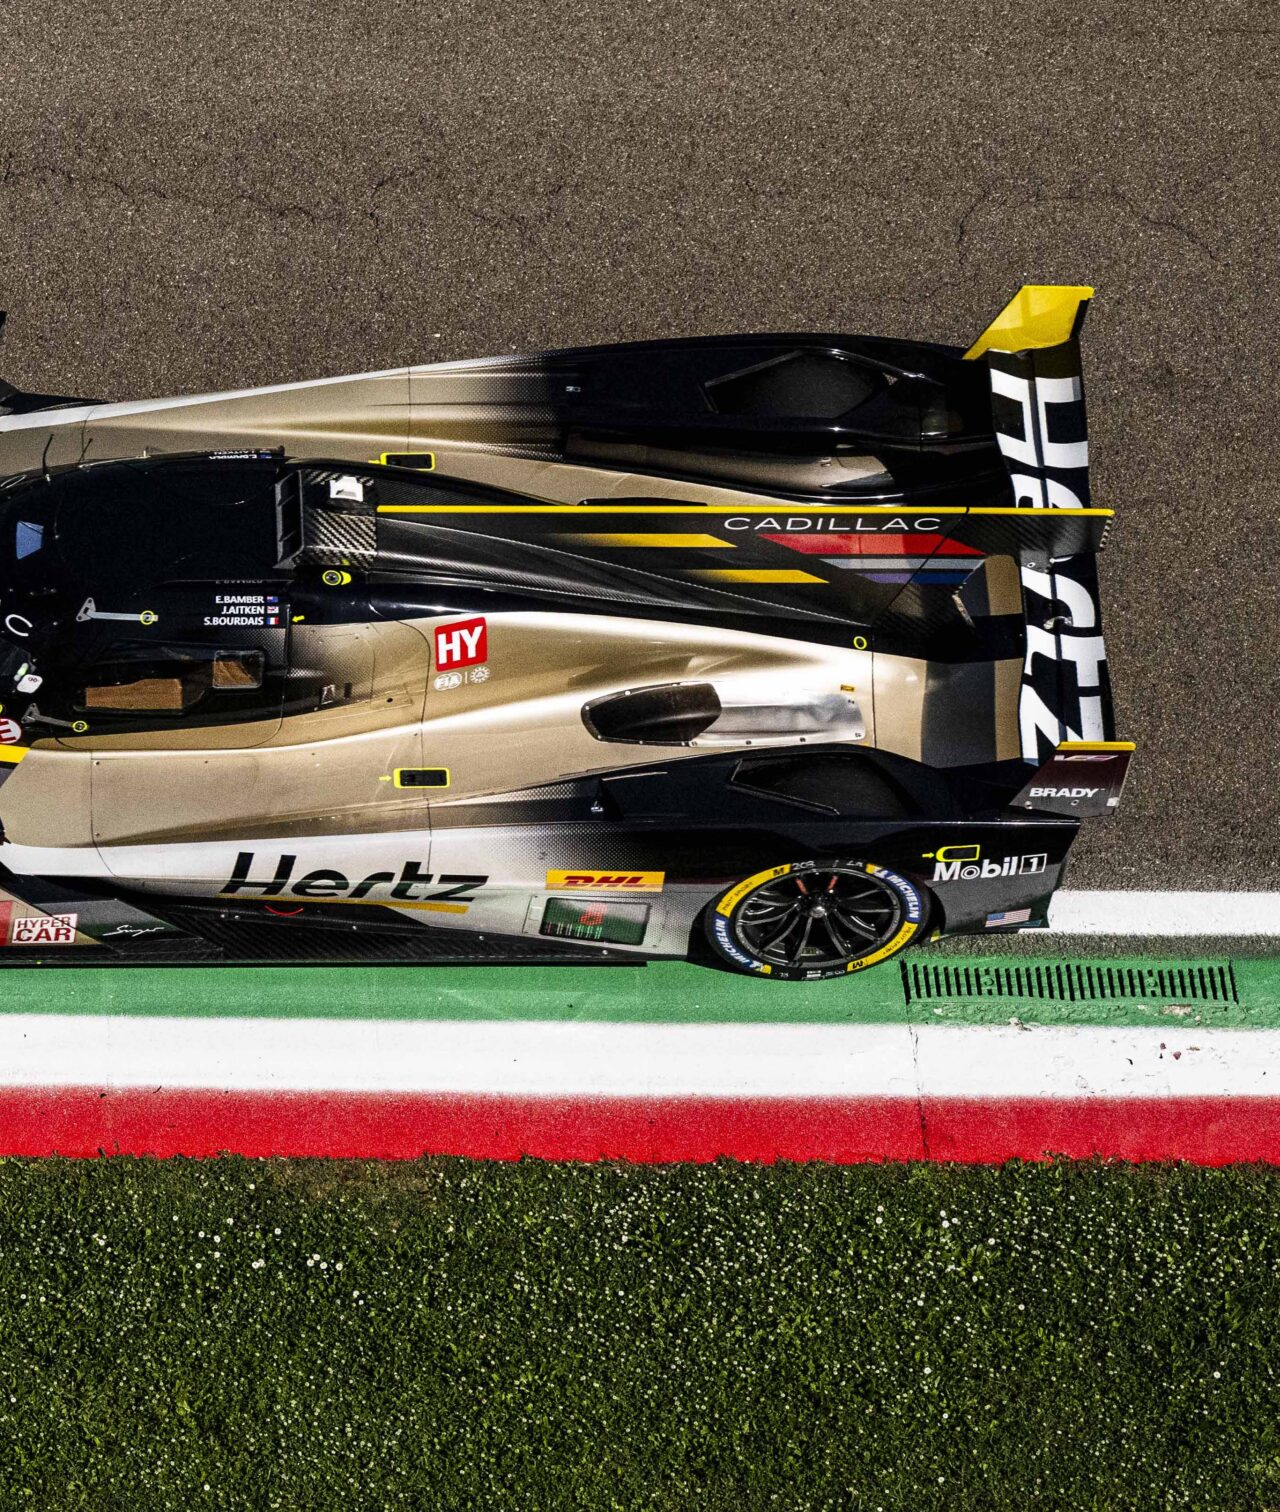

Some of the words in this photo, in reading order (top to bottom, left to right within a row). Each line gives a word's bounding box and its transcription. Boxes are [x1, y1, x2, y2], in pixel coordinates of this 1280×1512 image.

[724, 517, 941, 531] CADILLAC
[215, 595, 265, 604] E.BAMBER
[221, 605, 265, 615] J.AITKEN
[203, 616, 264, 626] S.BOURDAIS
[437, 625, 484, 665] HY
[435, 673, 461, 690] FIA
[1029, 787, 1099, 798] BRADY
[773, 867, 785, 876] M
[933, 856, 1019, 882] Mobil
[219, 852, 489, 903] Hertz
[563, 875, 645, 888] DHL
[887, 875, 920, 919] MICHELIN
[17, 916, 72, 929] HYPER
[15, 926, 71, 943] CAR
[102, 923, 166, 938] Singer
[715, 918, 751, 963] MICHELIN
[852, 961, 864, 969] M
